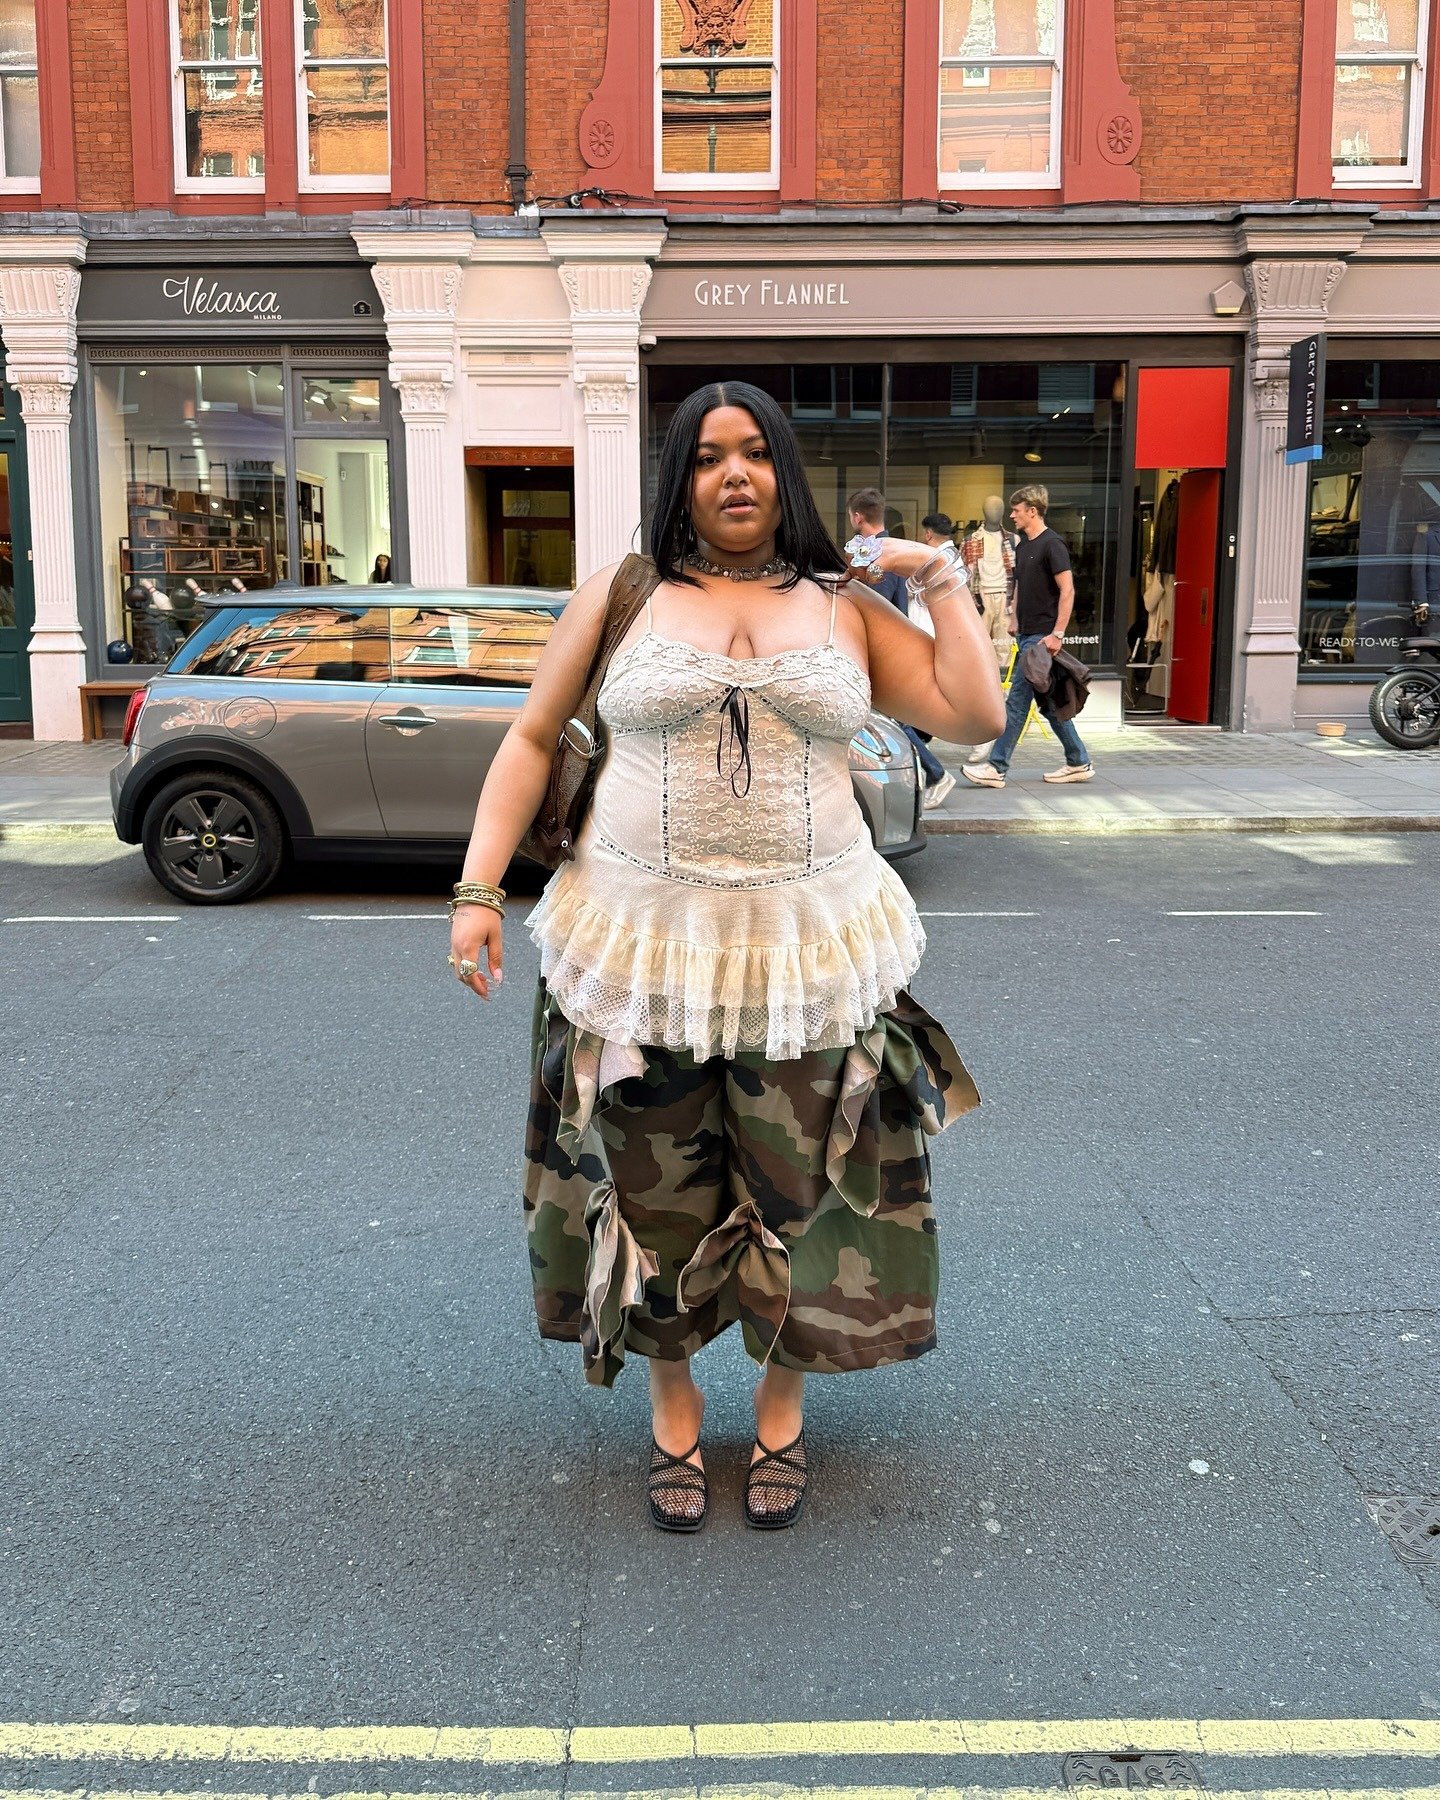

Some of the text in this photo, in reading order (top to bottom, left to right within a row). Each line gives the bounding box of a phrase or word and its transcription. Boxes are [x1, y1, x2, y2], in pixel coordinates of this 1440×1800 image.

[163, 276, 280, 314] Velasca
[358, 305, 366, 314] 5
[1062, 635, 1100, 645] nstreet
[1319, 637, 1404, 648] READY-TO-WE
[1099, 1765, 1168, 1789] GAS
